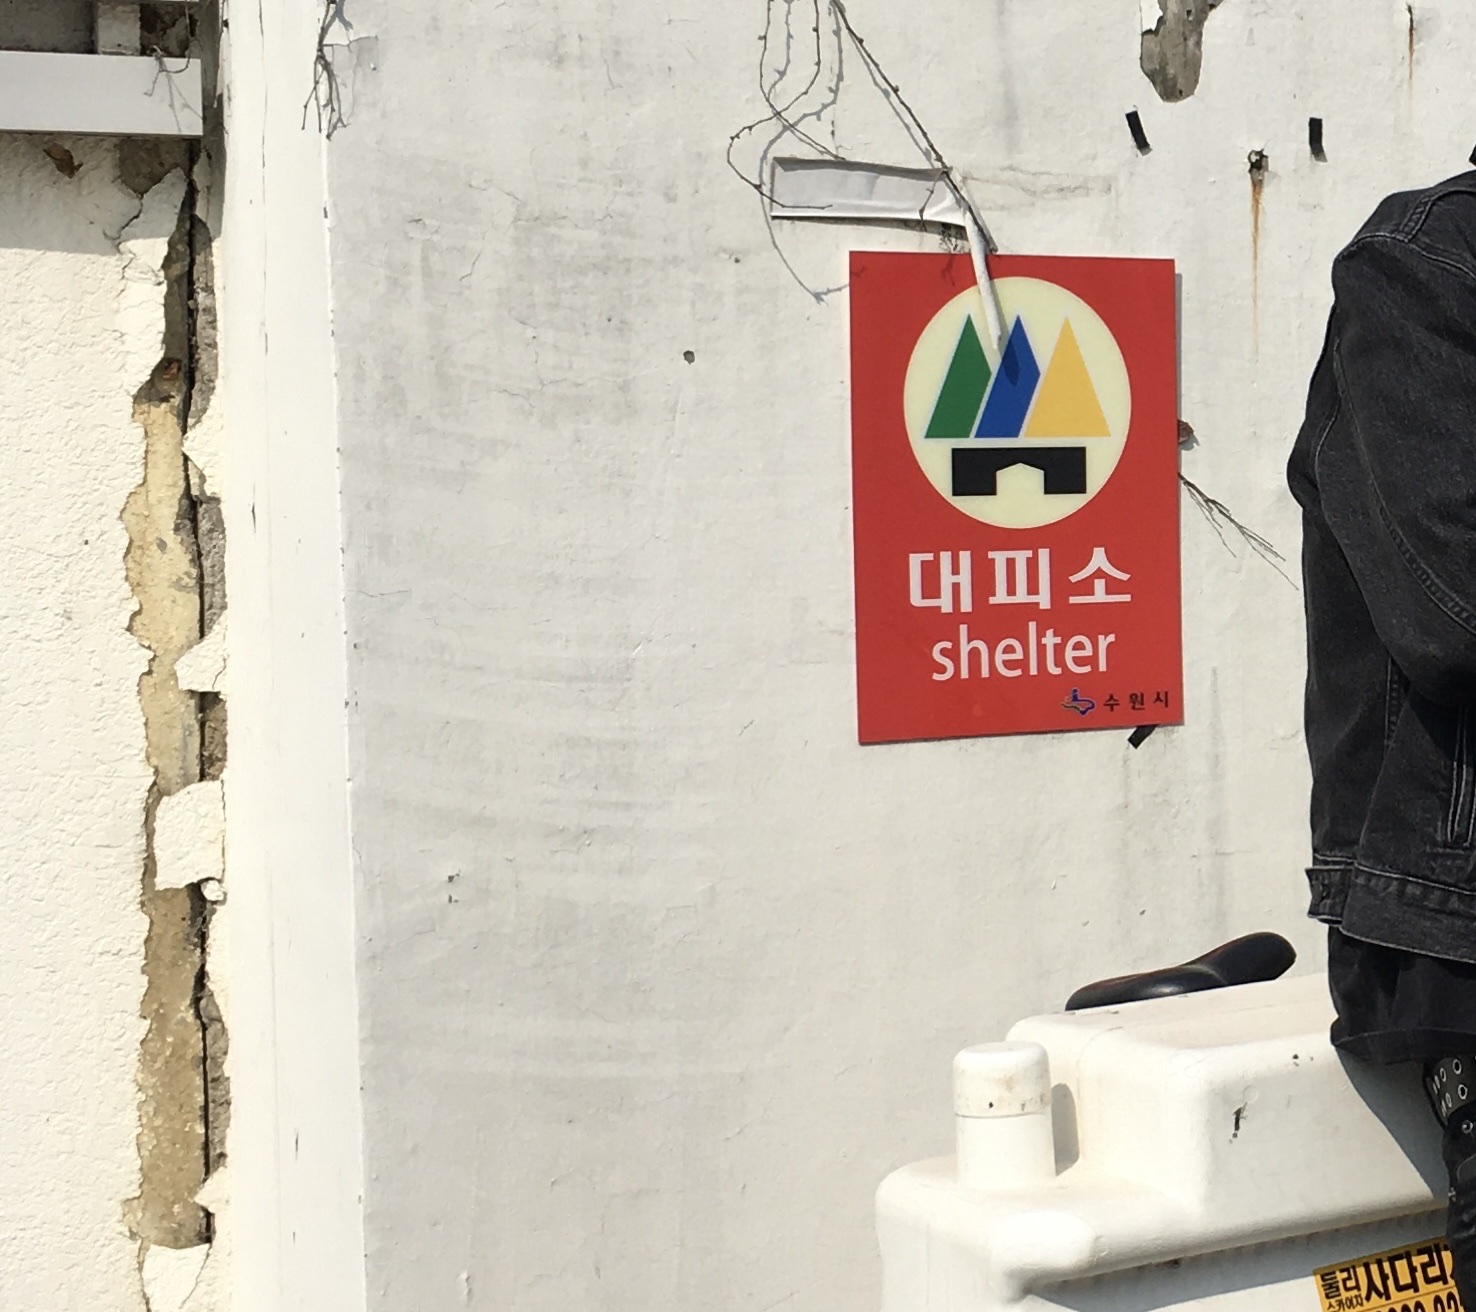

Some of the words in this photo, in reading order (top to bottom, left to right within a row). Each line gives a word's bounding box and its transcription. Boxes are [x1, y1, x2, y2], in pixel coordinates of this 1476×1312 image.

[908, 546, 1132, 614] 대피소
[931, 621, 1116, 682] shelter
[1102, 690, 1169, 712] 수원시
